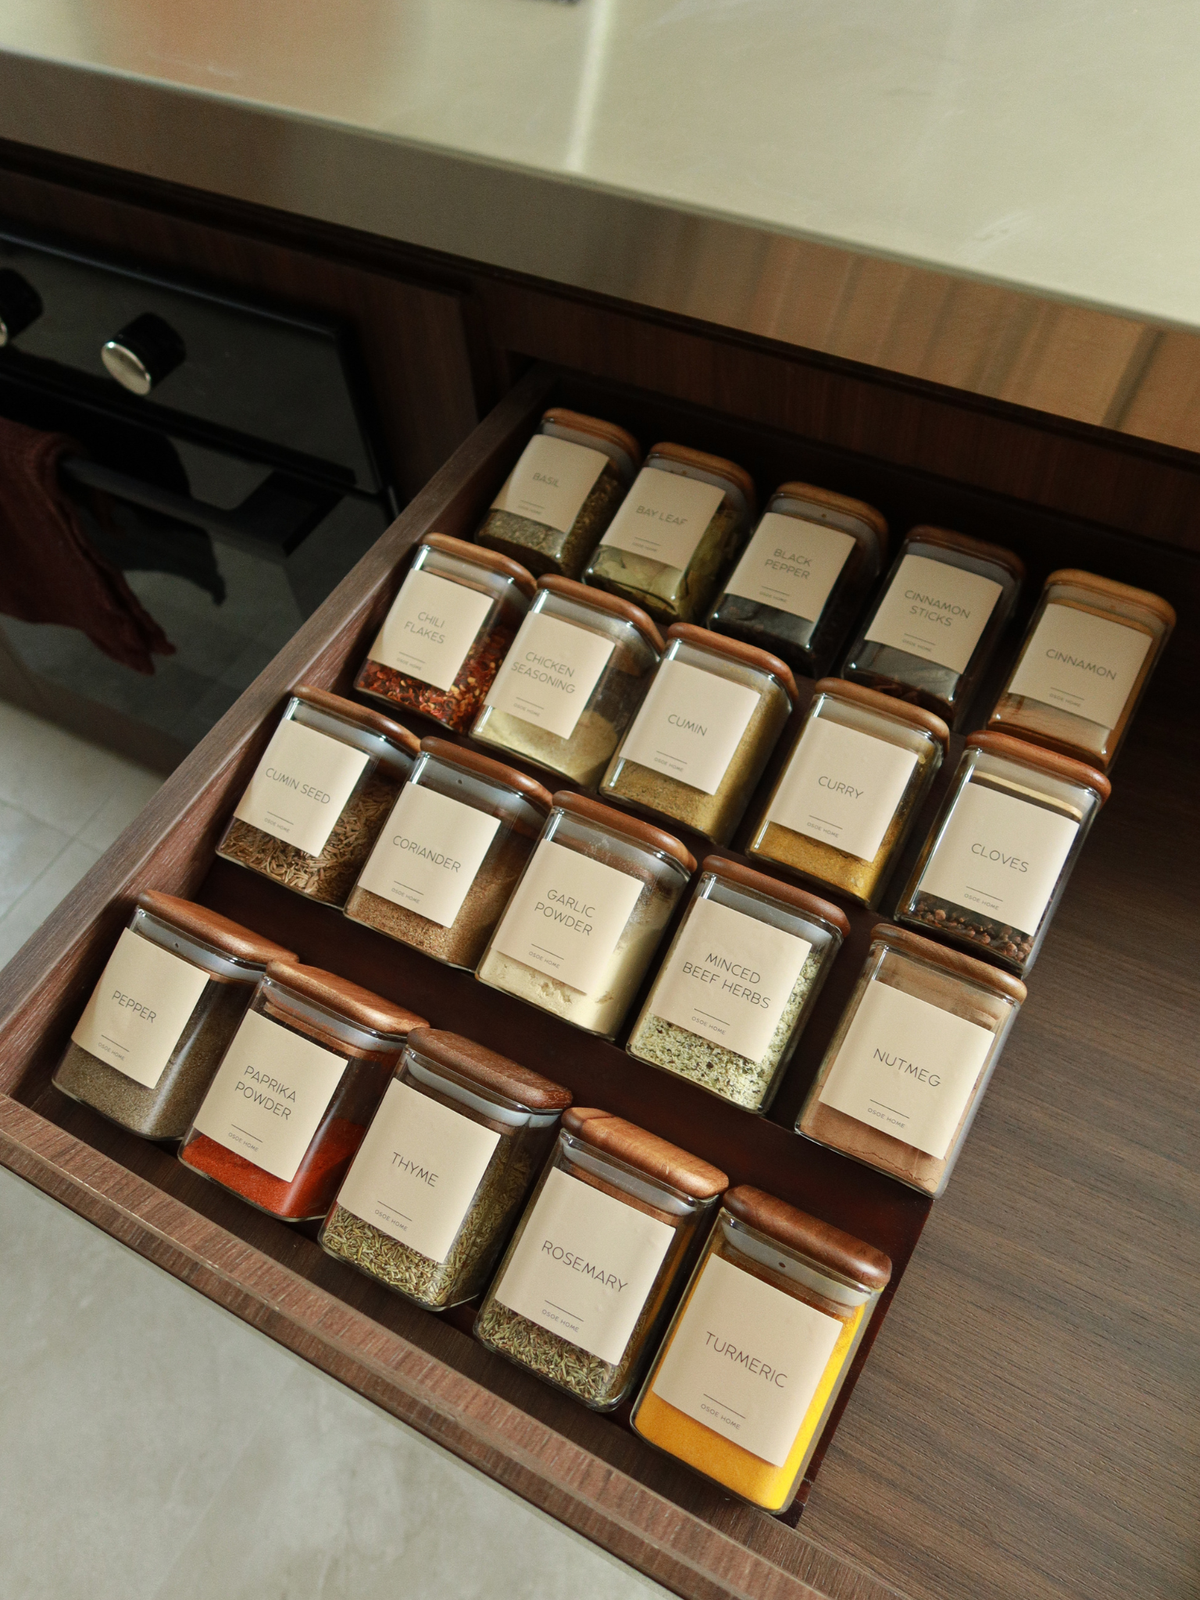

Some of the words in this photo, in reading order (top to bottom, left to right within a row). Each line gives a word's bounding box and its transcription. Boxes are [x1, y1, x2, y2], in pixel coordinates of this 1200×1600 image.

[532, 472, 559, 488] BASIL
[636, 505, 657, 519] BAY
[659, 510, 687, 527] LEAF
[764, 558, 810, 580] PEPPER
[773, 548, 813, 567] BLACK
[904, 589, 971, 619] CINNAMON
[909, 605, 952, 627] STICKS
[404, 621, 445, 644] FLAKES
[417, 611, 445, 628] CHILI
[511, 661, 576, 694] SEASONING
[525, 651, 575, 678] CHICKEN
[1046, 648, 1117, 681] CINNAMON
[667, 714, 708, 737] CUMIN
[265, 767, 300, 790] CUMIN
[300, 783, 331, 804] SEED
[818, 776, 864, 800] CURRY
[392, 835, 461, 873] CORIANDER
[971, 842, 1029, 873] CLOVES
[547, 889, 596, 918] GARLIC
[981, 900, 999, 911] HOME
[534, 902, 593, 936] POWDER
[705, 953, 761, 984] MINCED
[682, 961, 721, 985] BEEF
[721, 979, 771, 1009] HERBS
[111, 990, 157, 1024] PEPPER
[691, 1016, 708, 1027] OSOE
[708, 1024, 726, 1035] HOME
[873, 1048, 941, 1087] NUTMEG
[244, 1065, 297, 1103] PAPRIKA
[234, 1081, 292, 1120] POWDER
[867, 1107, 886, 1119] OSOE
[886, 1116, 905, 1128] HOME
[228, 1132, 242, 1143] OSOE
[243, 1140, 259, 1152] HOME
[392, 1151, 439, 1188] THYME
[374, 1209, 390, 1222] OSOE
[391, 1219, 408, 1232] HOME
[541, 1240, 628, 1293] ROSEMARY
[541, 1309, 559, 1322] OSOE
[560, 1319, 580, 1333] HOME
[705, 1331, 788, 1389] TURMERIC
[700, 1403, 719, 1417] OSOE
[720, 1415, 741, 1430] HOME
